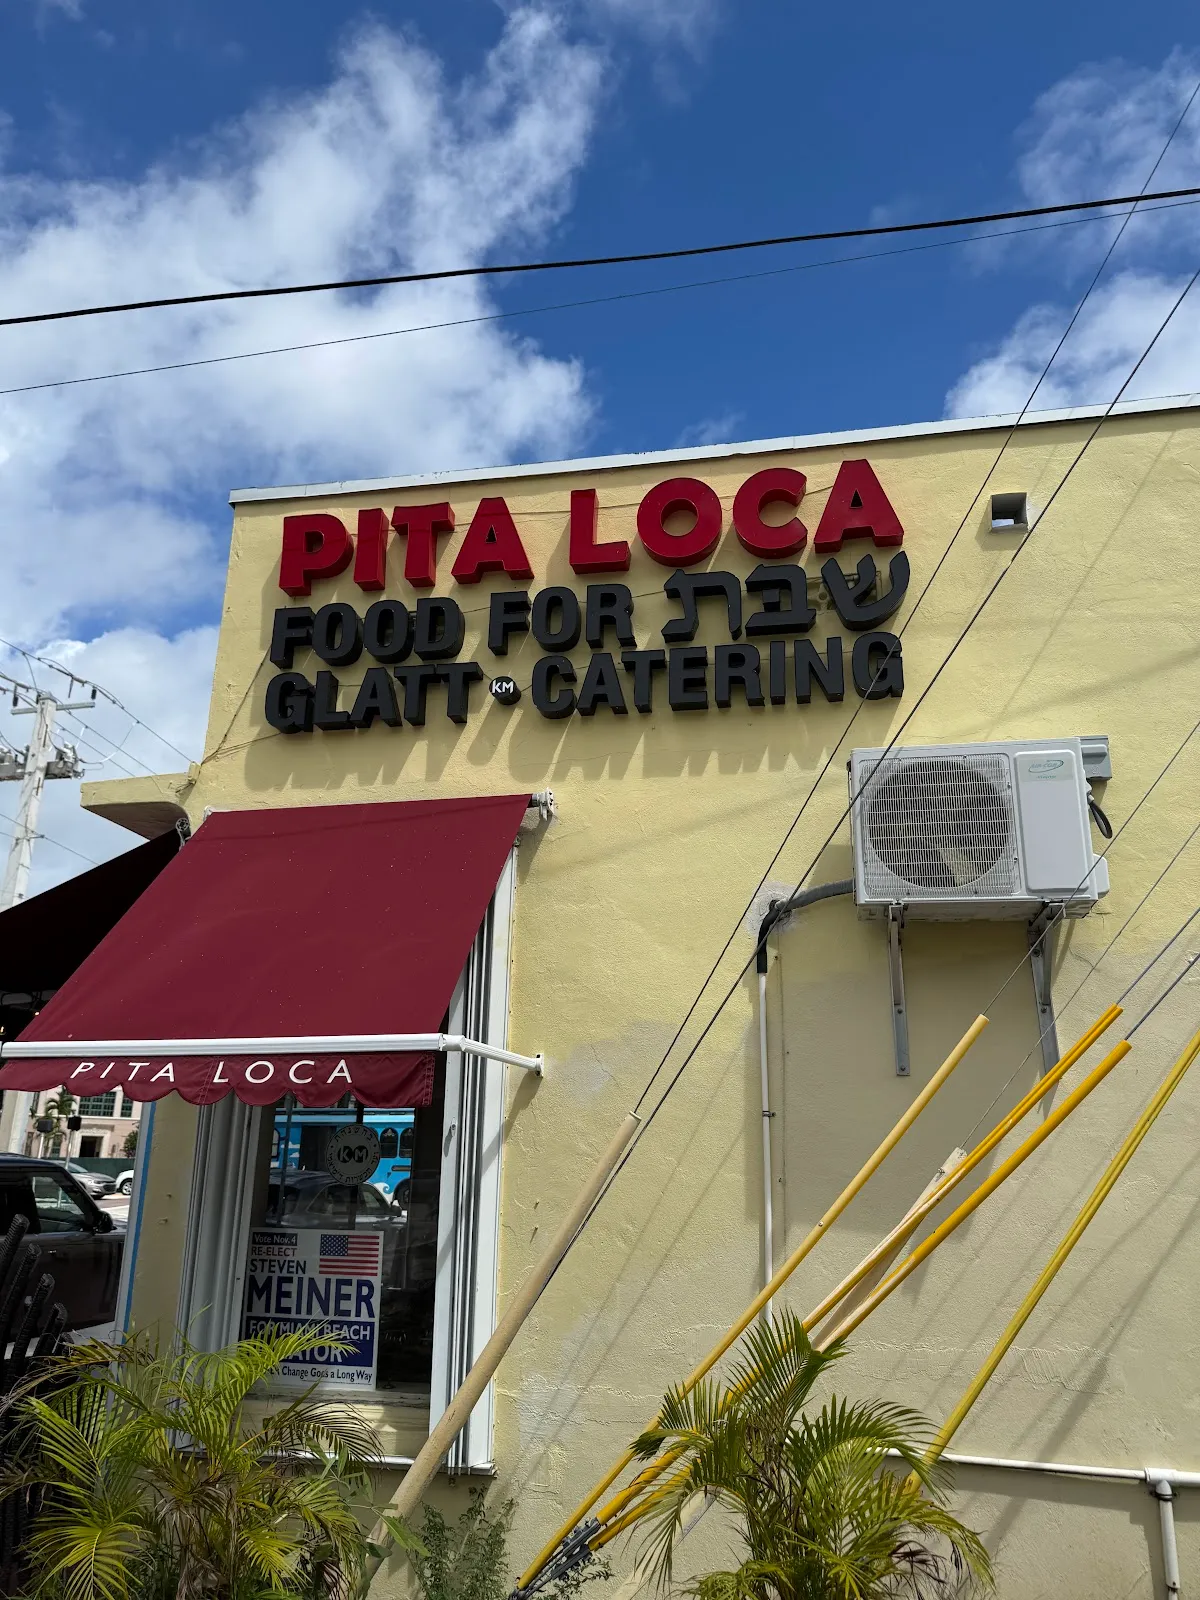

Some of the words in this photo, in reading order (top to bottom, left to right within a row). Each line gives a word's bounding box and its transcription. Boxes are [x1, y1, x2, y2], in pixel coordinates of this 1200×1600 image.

[279, 497, 534, 597] PITA
[569, 459, 904, 574] LOCA
[270, 597, 465, 669] FOOD
[487, 583, 636, 656] FOR
[661, 551, 910, 643] שבת
[265, 661, 483, 734] GLATT
[491, 680, 514, 694] KM
[531, 631, 905, 719] CATERING
[70, 1062, 175, 1082] PITA
[213, 1059, 353, 1084] LOCA
[340, 1146, 368, 1164] KM
[254, 1233, 271, 1244] Vote
[251, 1247, 298, 1257] RE-ELECT
[250, 1259, 307, 1274] STEVEN
[247, 1275, 375, 1318] MEINER
[250, 1320, 275, 1335] FOR
[324, 1324, 370, 1340] BEACH
[282, 1366, 308, 1379] Change
[330, 1370, 335, 1378] a
[336, 1368, 355, 1381] Long
[356, 1369, 373, 1383] Way
